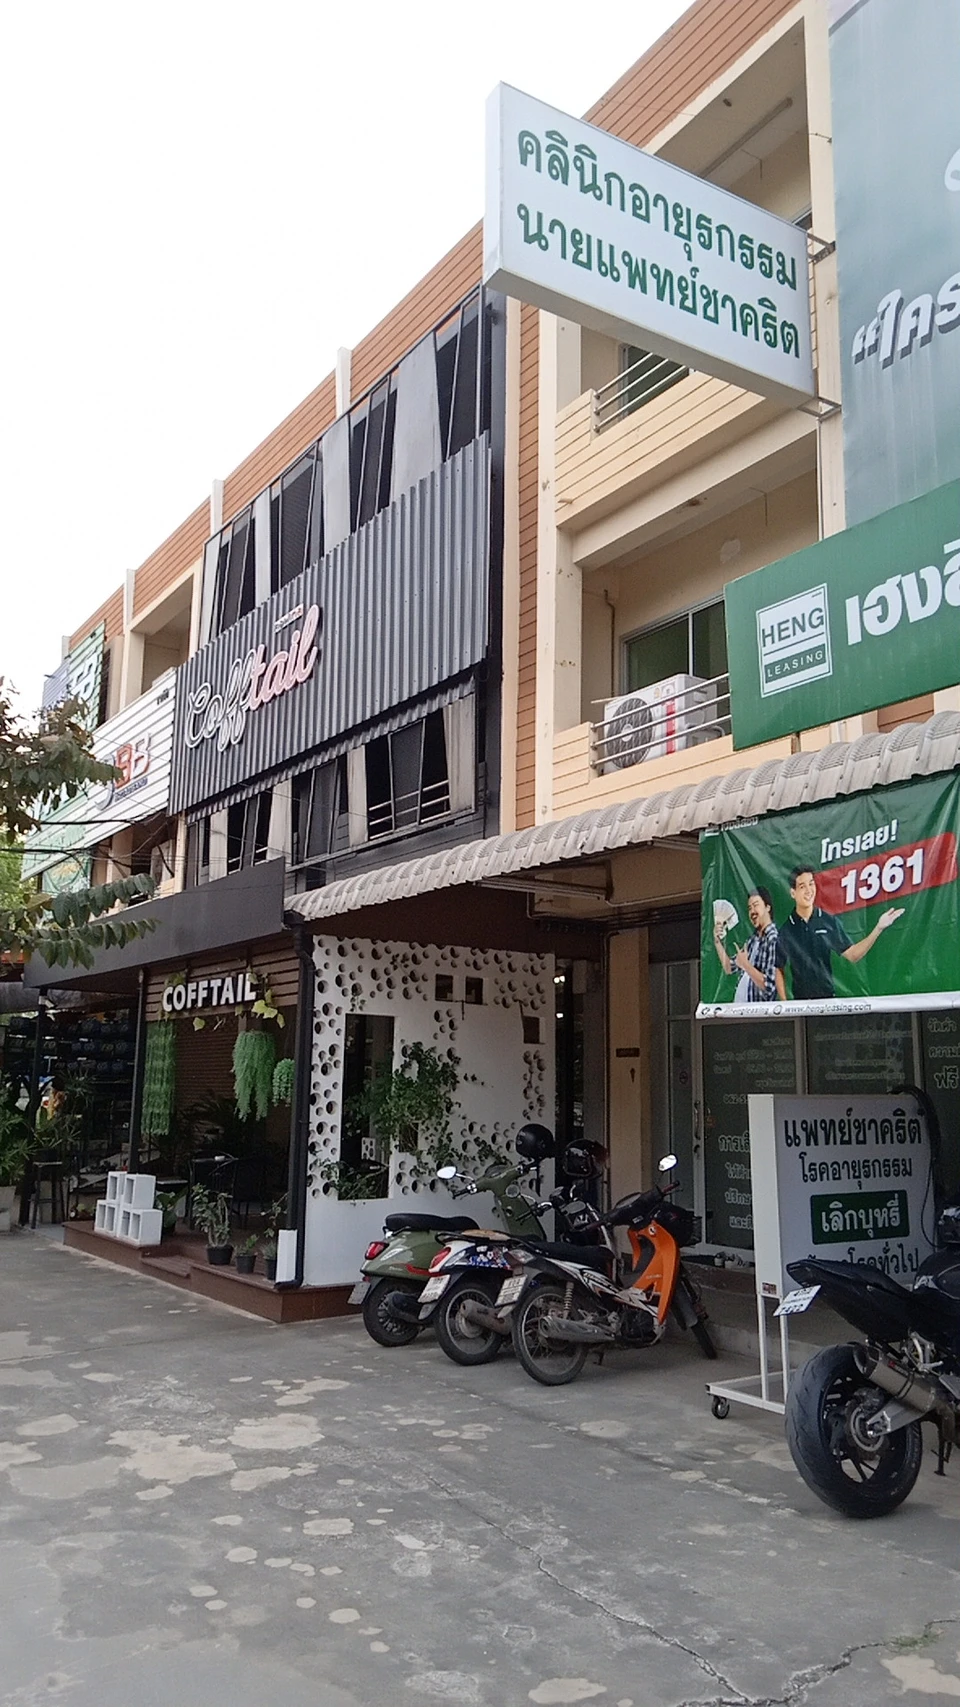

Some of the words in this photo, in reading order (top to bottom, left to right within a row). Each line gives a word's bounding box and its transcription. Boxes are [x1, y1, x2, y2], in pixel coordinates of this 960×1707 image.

[517, 129, 797, 291] คลินิกอายุรกรรม
[516, 203, 800, 359] นายแพทย์ชาคริต
[761, 607, 824, 648] HENG
[767, 650, 823, 678] LEASING
[820, 819, 898, 864] โทรเลย!
[840, 848, 924, 904] 1361
[162, 973, 257, 1012] COFFTAIL
[934, 1065, 959, 1089] ฟรี
[784, 1107, 922, 1148] แพทย์ชาคริต
[799, 1151, 912, 1191] โรคอายุรกรรม
[821, 1193, 901, 1239] เลิกบุหรี่
